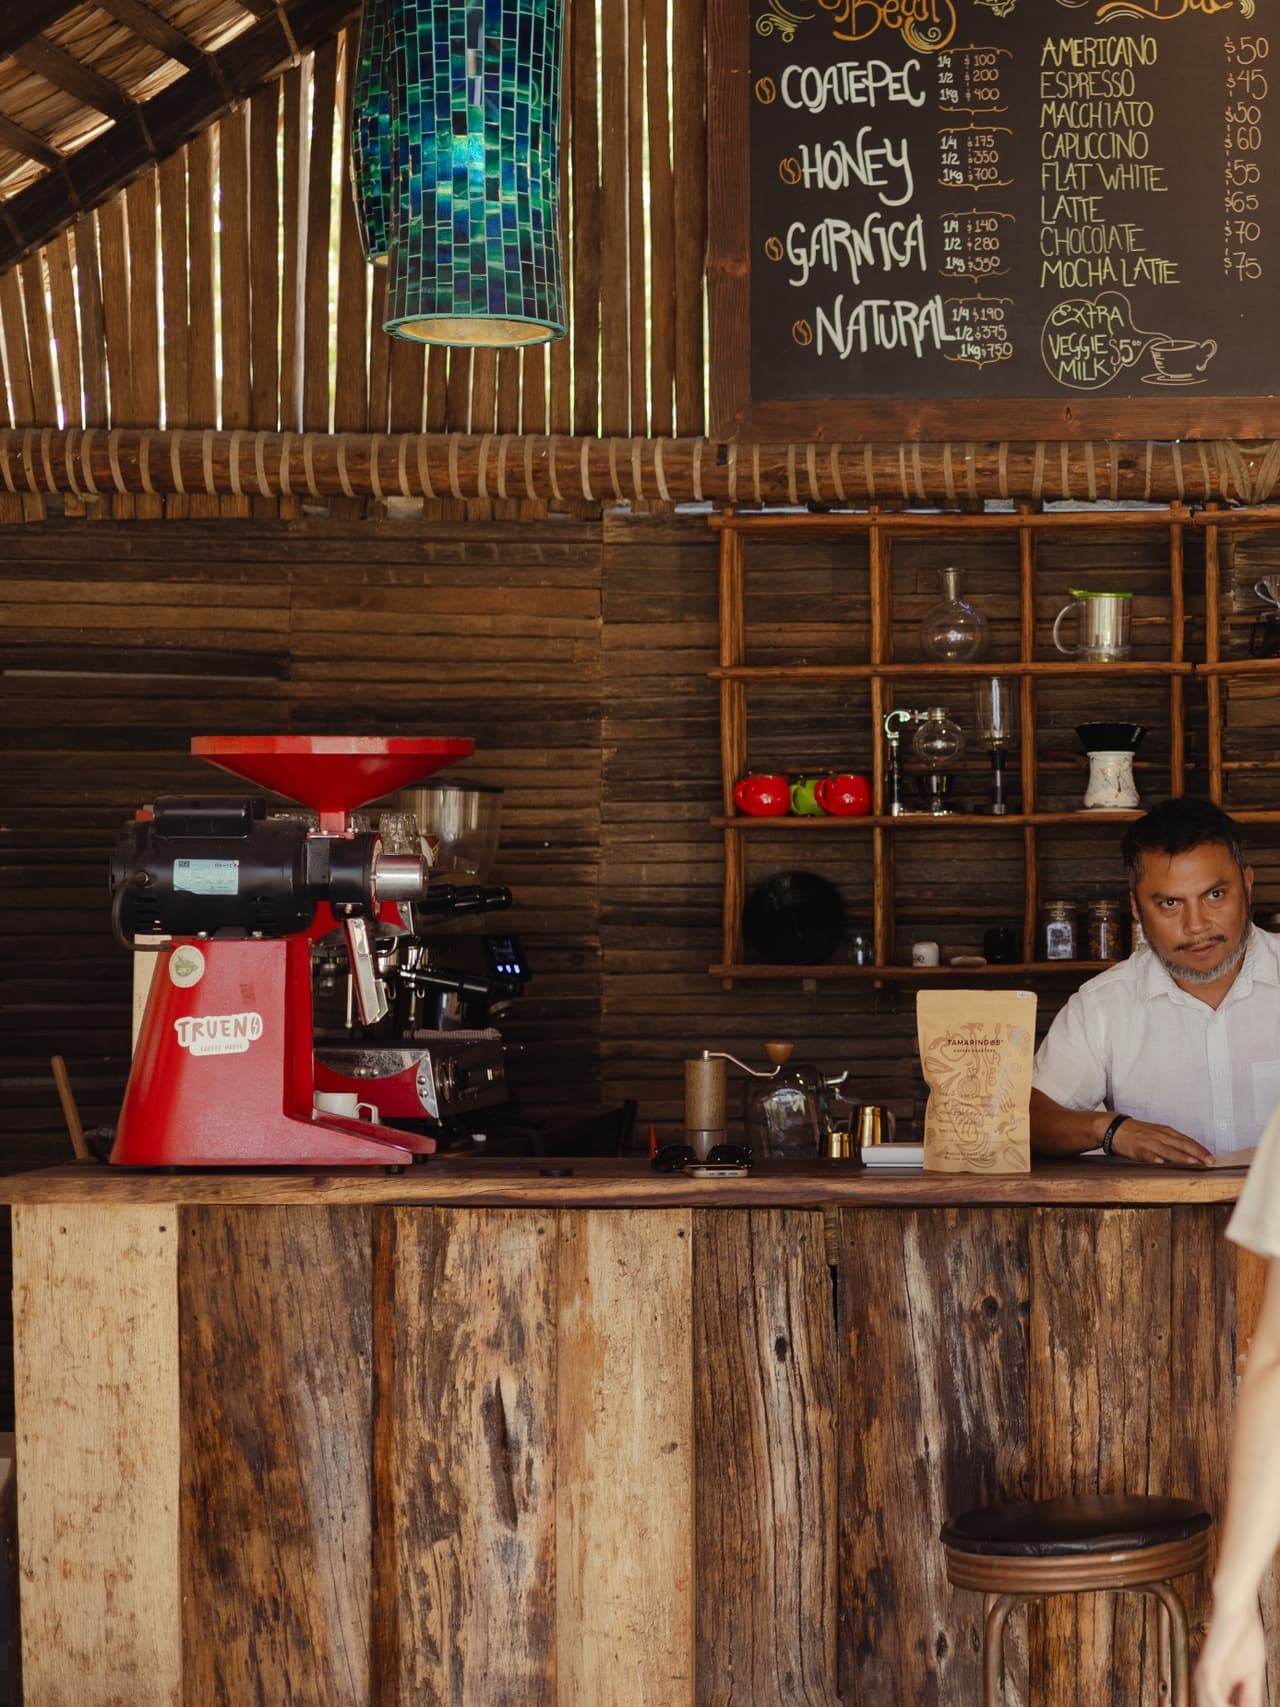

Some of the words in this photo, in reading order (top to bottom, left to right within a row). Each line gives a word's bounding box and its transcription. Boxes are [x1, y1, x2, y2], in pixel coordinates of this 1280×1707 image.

[1040, 35, 1158, 68] AMERICANO
[1223, 36, 1269, 65] $50
[781, 59, 926, 113] COATEPEC
[938, 71, 954, 84] 1/2
[1040, 69, 1136, 99] ESPRESSO
[1226, 69, 1268, 100] $45
[1039, 101, 1154, 128] MACCHIATO
[1224, 101, 1262, 131] $50
[940, 135, 958, 149] 1/4
[1040, 129, 1150, 160] CAPUCCINO
[1223, 126, 1262, 156] $60
[799, 126, 915, 206] HONEY
[941, 152, 961, 165] 1/2
[1041, 162, 1094, 191] FLAT
[1096, 163, 1169, 191] WHITE
[1224, 159, 1261, 192] $55
[1040, 195, 1106, 225] LATTE
[1224, 190, 1260, 214] $65
[943, 220, 959, 234] 1/4
[1040, 224, 1147, 257] CHOCOLATE
[1224, 220, 1262, 245] $70
[786, 212, 927, 287] GARNICA
[943, 237, 963, 251] 1/2
[1040, 256, 1119, 289] MOCHA
[1120, 256, 1181, 287] LATTE
[1223, 247, 1263, 282] $75
[815, 294, 956, 360] NATURAL
[951, 307, 970, 322] 1/4
[1051, 303, 1125, 335] EXTRA
[954, 326, 974, 342] 1/2
[1048, 332, 1109, 361] VEGGIE
[1058, 359, 1111, 381] MILK
